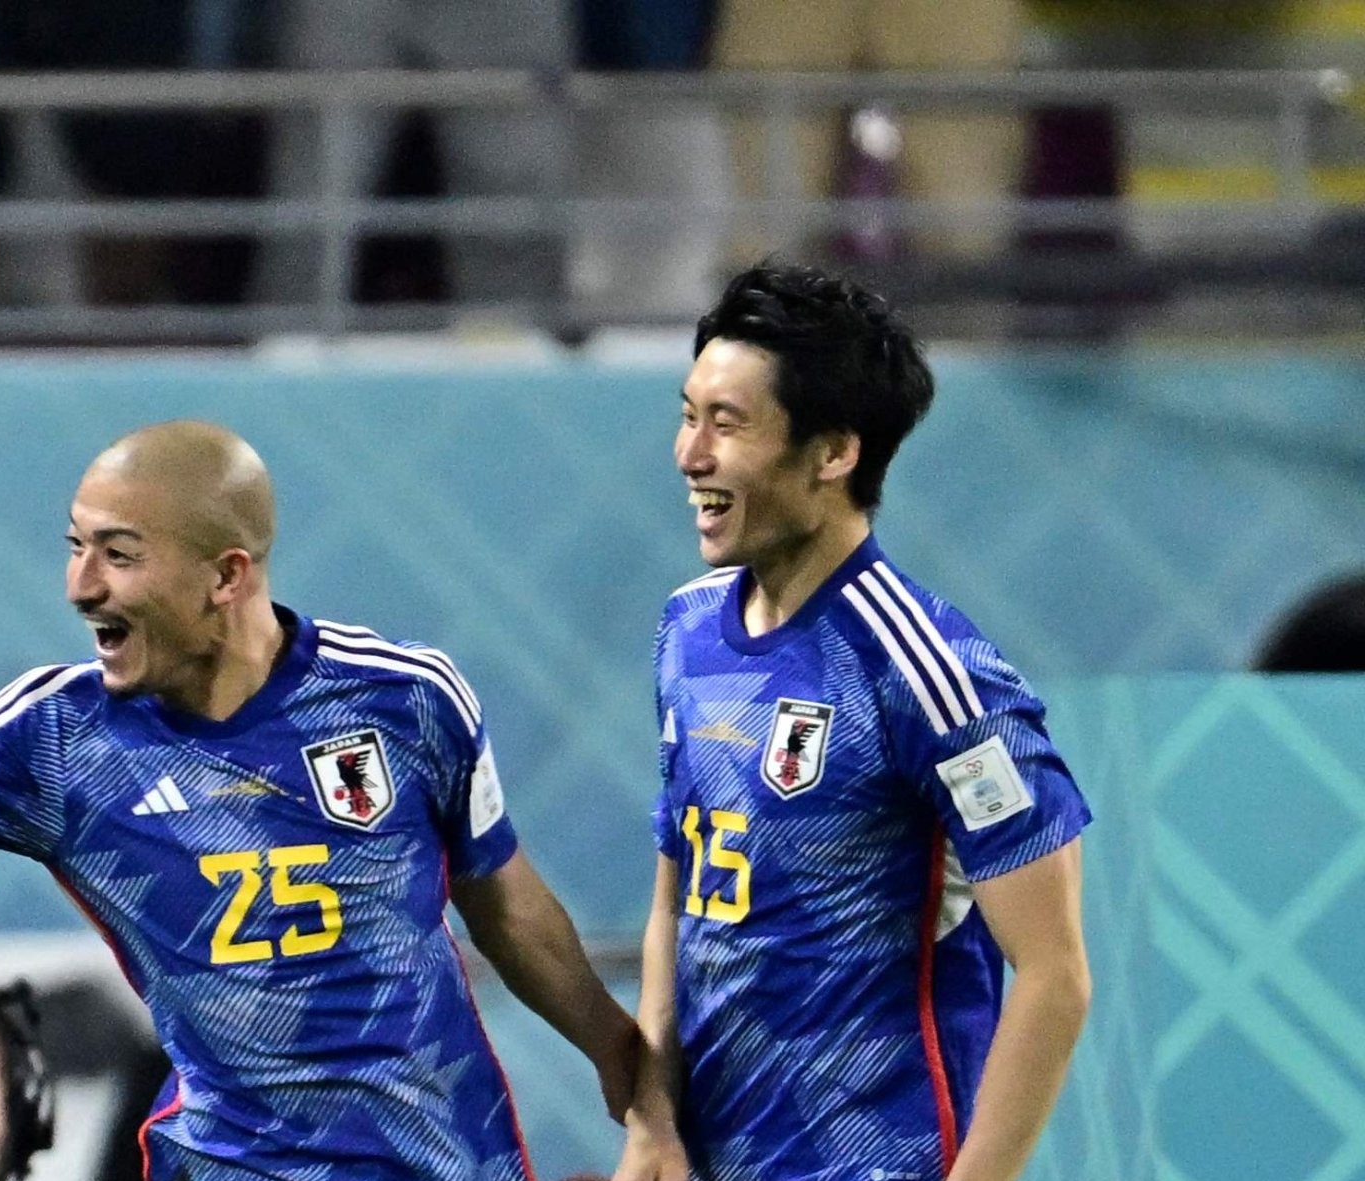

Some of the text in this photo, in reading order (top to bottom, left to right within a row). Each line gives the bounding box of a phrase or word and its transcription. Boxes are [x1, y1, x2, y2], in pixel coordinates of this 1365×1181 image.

[322, 736, 362, 753] JAPAN
[198, 843, 343, 965] 25
[682, 805, 751, 924] 15
